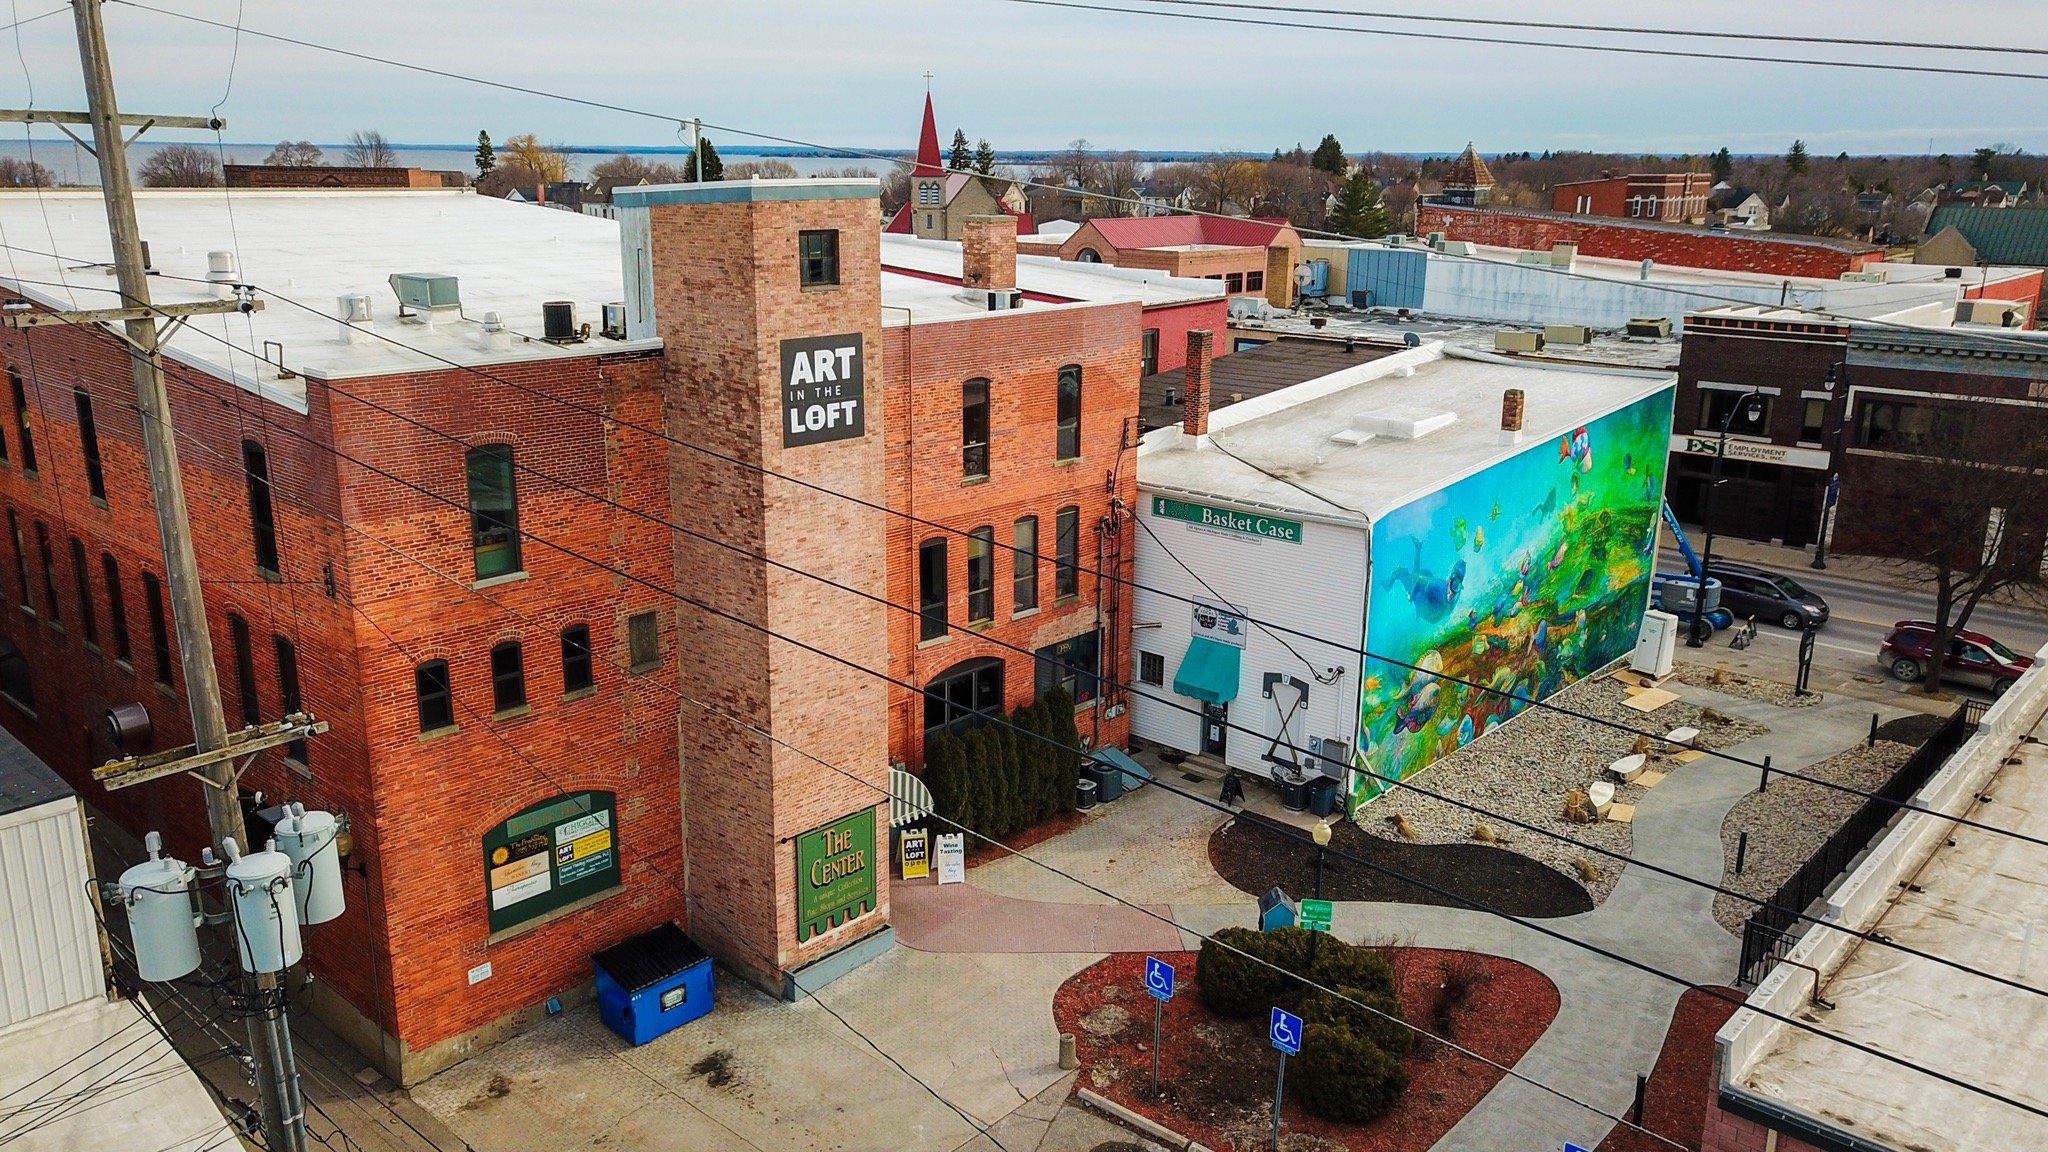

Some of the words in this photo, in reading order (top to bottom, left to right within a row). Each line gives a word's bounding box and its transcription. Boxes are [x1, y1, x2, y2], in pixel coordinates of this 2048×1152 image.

[790, 347, 856, 385] ART
[790, 389, 805, 401] IN
[815, 385, 841, 398] THE
[790, 400, 857, 434] LOFT
[1685, 438, 1725, 456] ES
[1728, 444, 1787, 456] EMPLOYMENT
[1728, 450, 1768, 460] SERVICES,
[1202, 508, 1251, 531] Basket
[1256, 518, 1293, 540] Case
[559, 844, 573, 855] ART
[905, 840, 924, 849] ART
[559, 854, 573, 863] LOFT
[905, 851, 925, 859] LOFT
